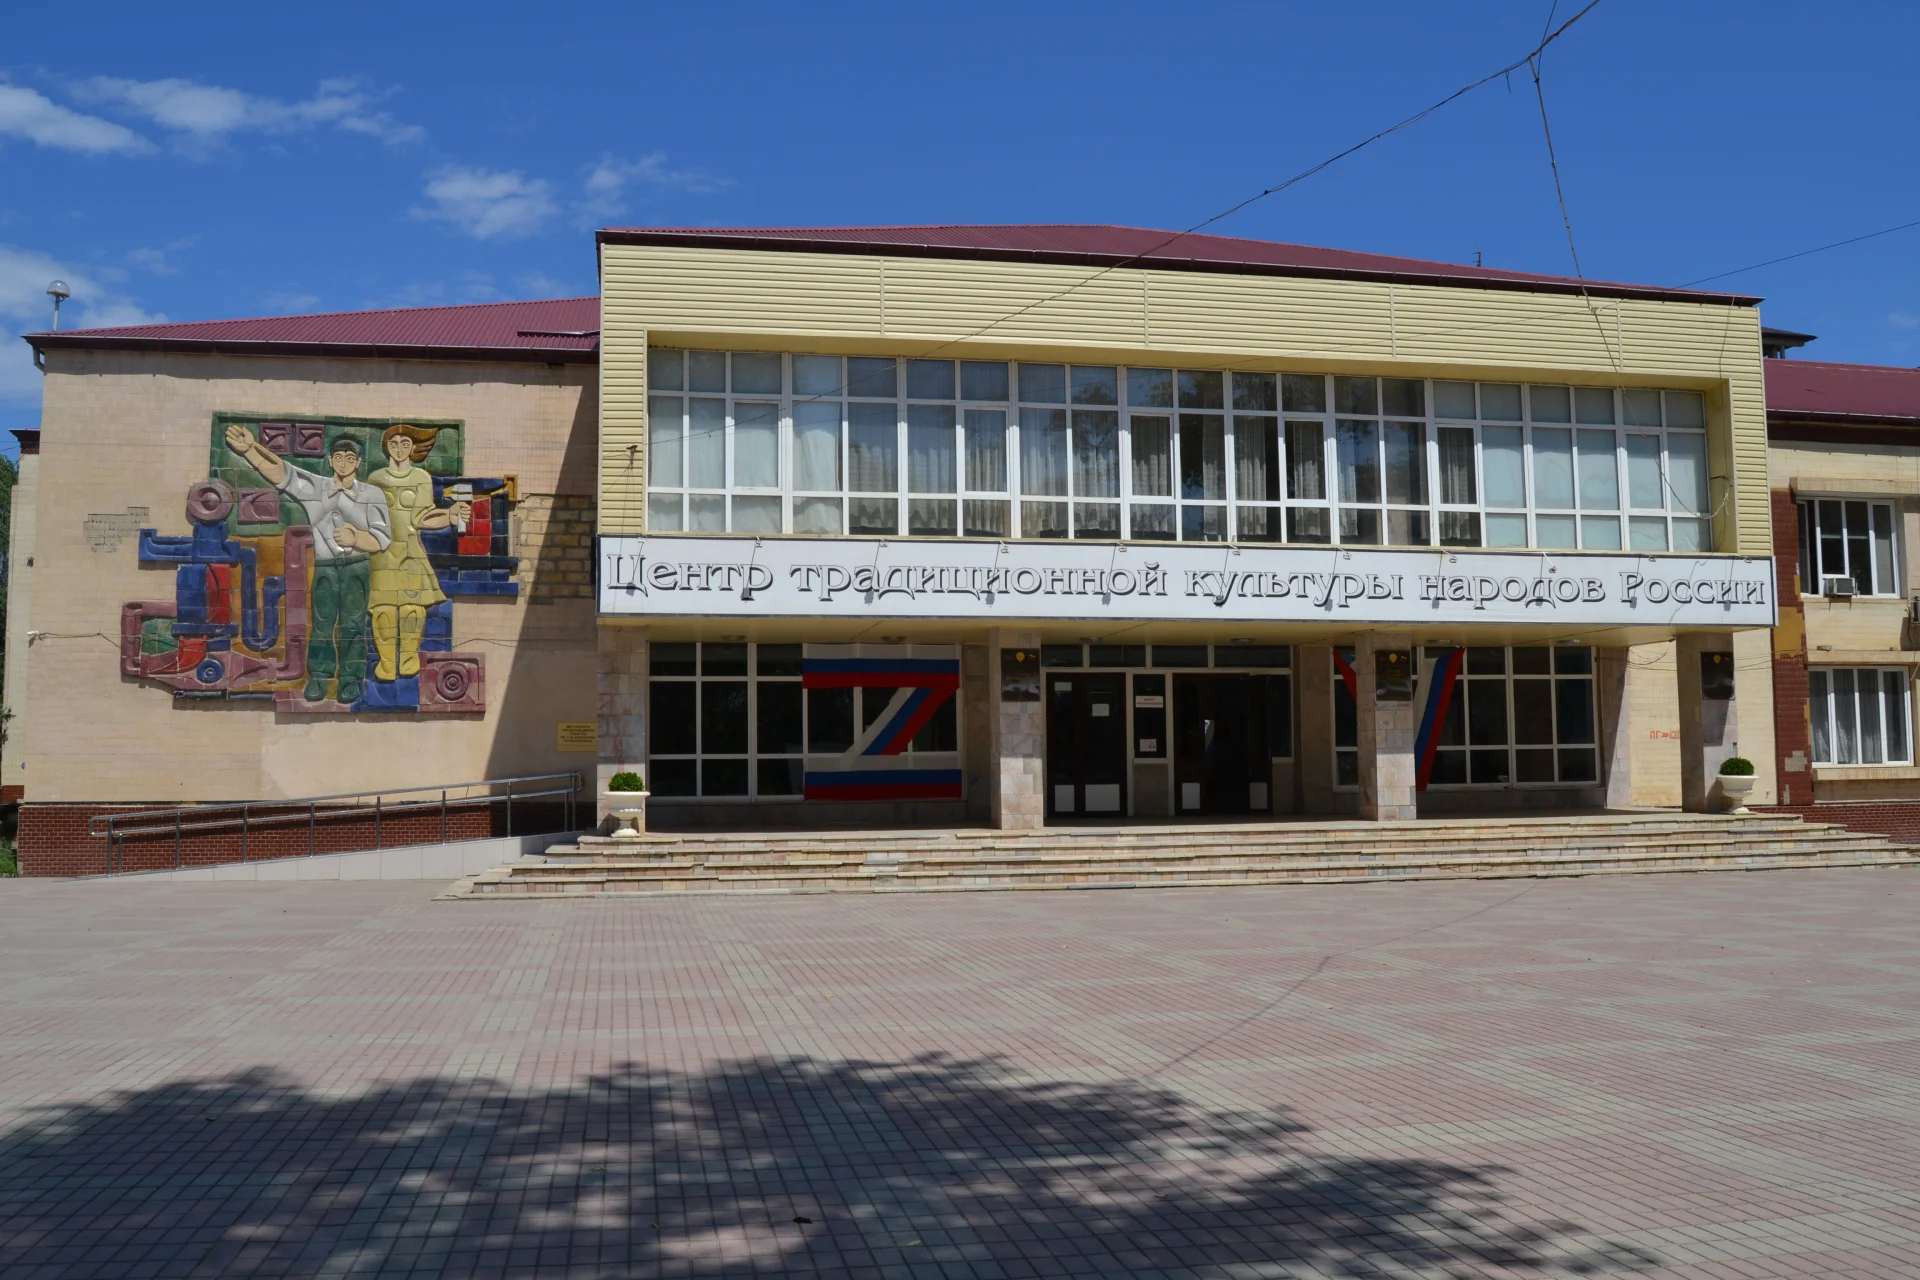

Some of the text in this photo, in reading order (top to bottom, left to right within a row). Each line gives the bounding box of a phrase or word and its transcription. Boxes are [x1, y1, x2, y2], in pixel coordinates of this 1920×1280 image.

[606, 554, 1765, 610] Центр традиционной культуры народов России
[802, 643, 962, 800] Z
